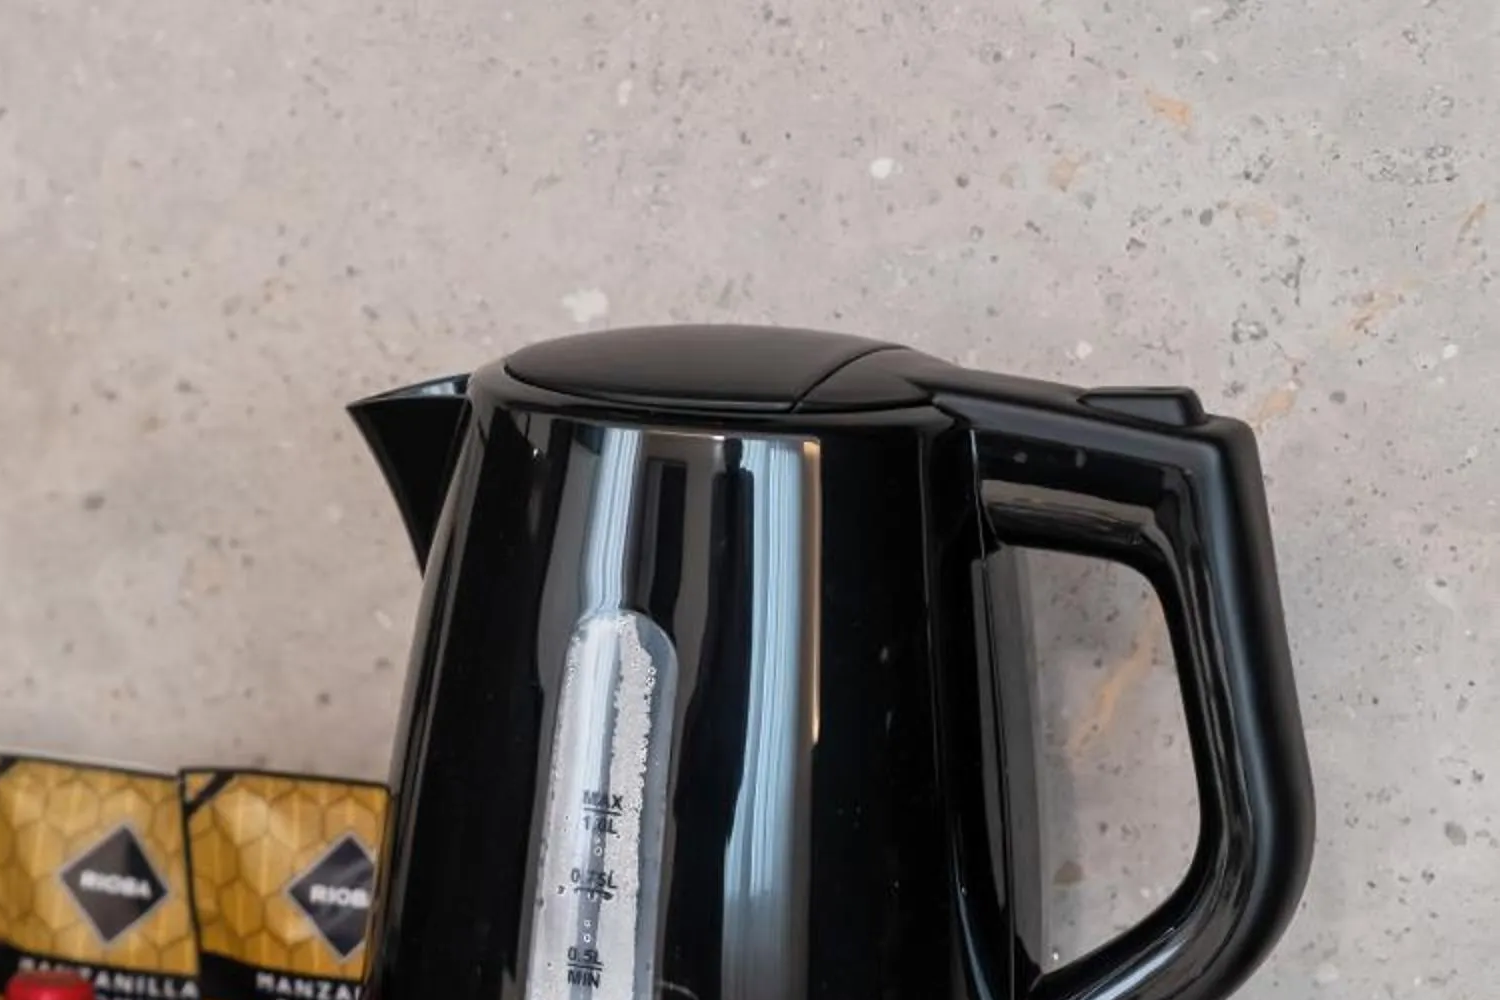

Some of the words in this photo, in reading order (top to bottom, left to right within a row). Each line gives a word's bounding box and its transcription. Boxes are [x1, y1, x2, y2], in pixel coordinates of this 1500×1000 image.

[80, 869, 151, 898] RIOBA
[309, 884, 369, 909] RIOB
[567, 969, 601, 989] MIN
